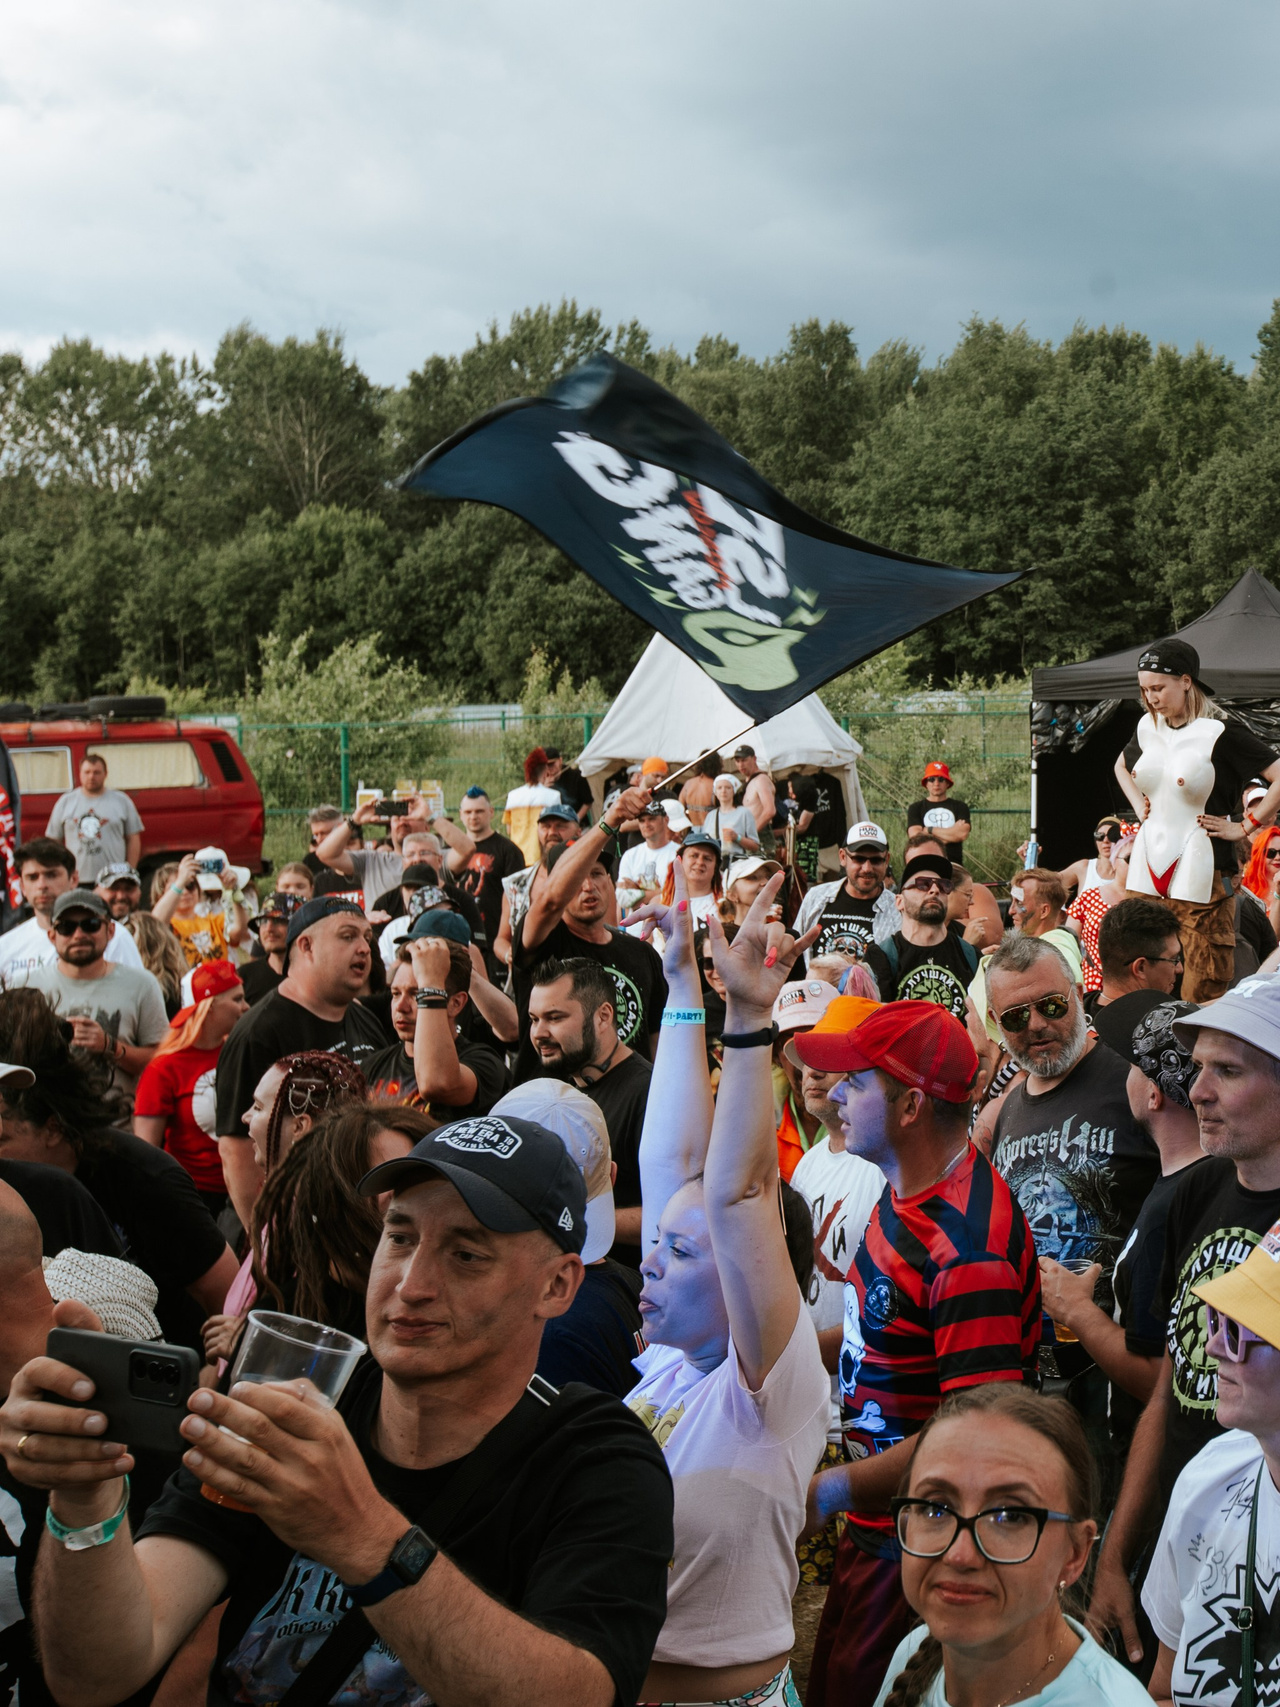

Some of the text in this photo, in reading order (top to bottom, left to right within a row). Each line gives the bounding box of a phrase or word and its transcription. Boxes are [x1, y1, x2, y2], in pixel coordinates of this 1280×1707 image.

[908, 969, 955, 987] ЛУЧШИЙ
[617, 1001, 637, 1040] САМЫ
[663, 1012, 703, 1020] NTI-PARTY
[455, 1126, 480, 1134] NEW
[477, 1129, 500, 1143] ERA
[1058, 1114, 1117, 1166] Hill
[496, 1142, 510, 1153] 20
[1191, 1240, 1252, 1279] ЛУЧШ
